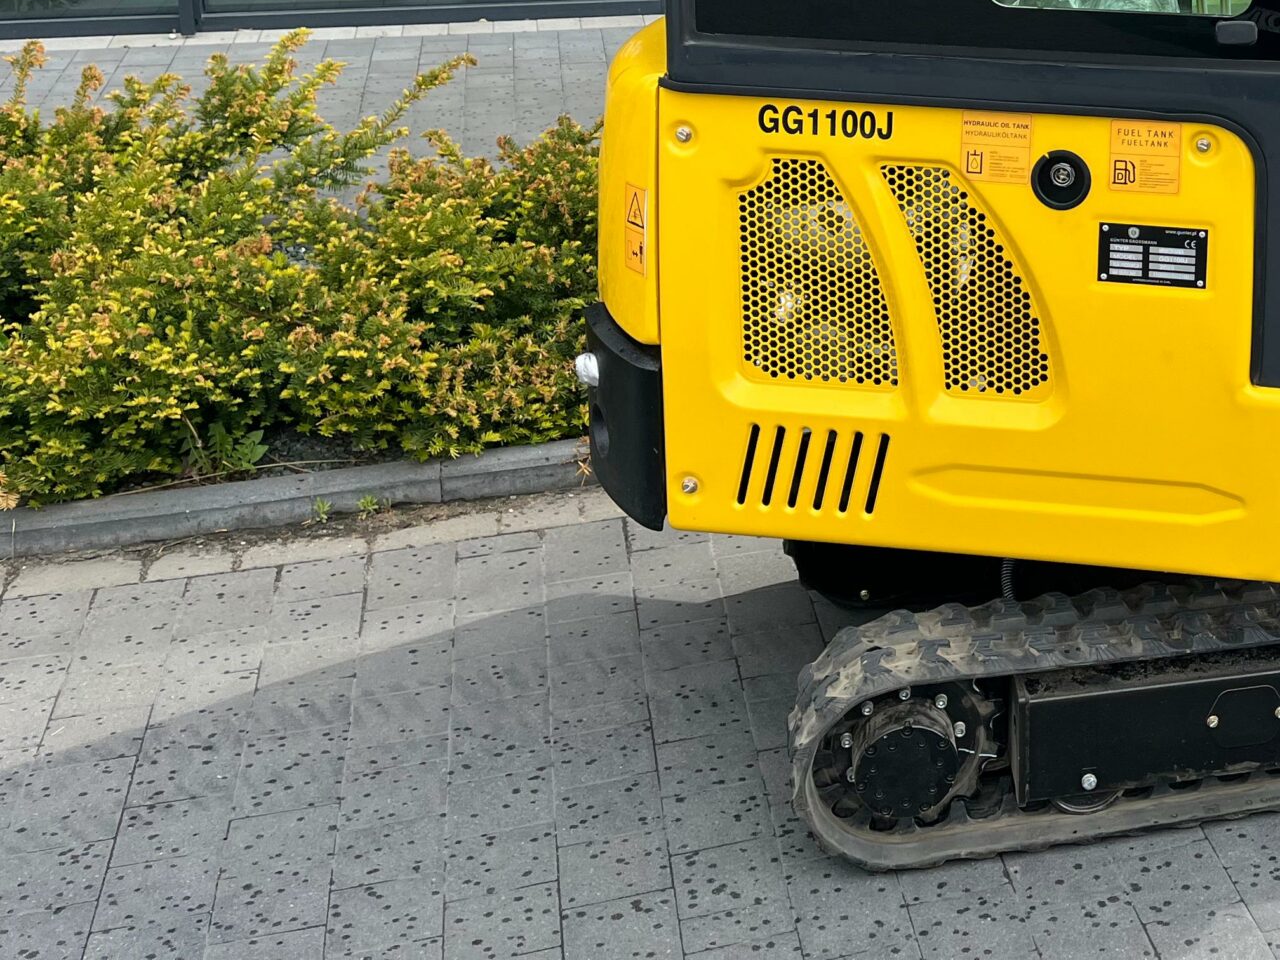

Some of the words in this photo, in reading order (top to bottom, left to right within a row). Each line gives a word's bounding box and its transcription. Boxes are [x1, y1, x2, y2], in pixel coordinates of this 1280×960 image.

[757, 103, 894, 141] GG1100J
[963, 120, 999, 128] HYDRAULIC
[1117, 128, 1142, 137] FUEL
[1147, 130, 1174, 139] TANK
[1121, 138, 1169, 148] FUELTANK
